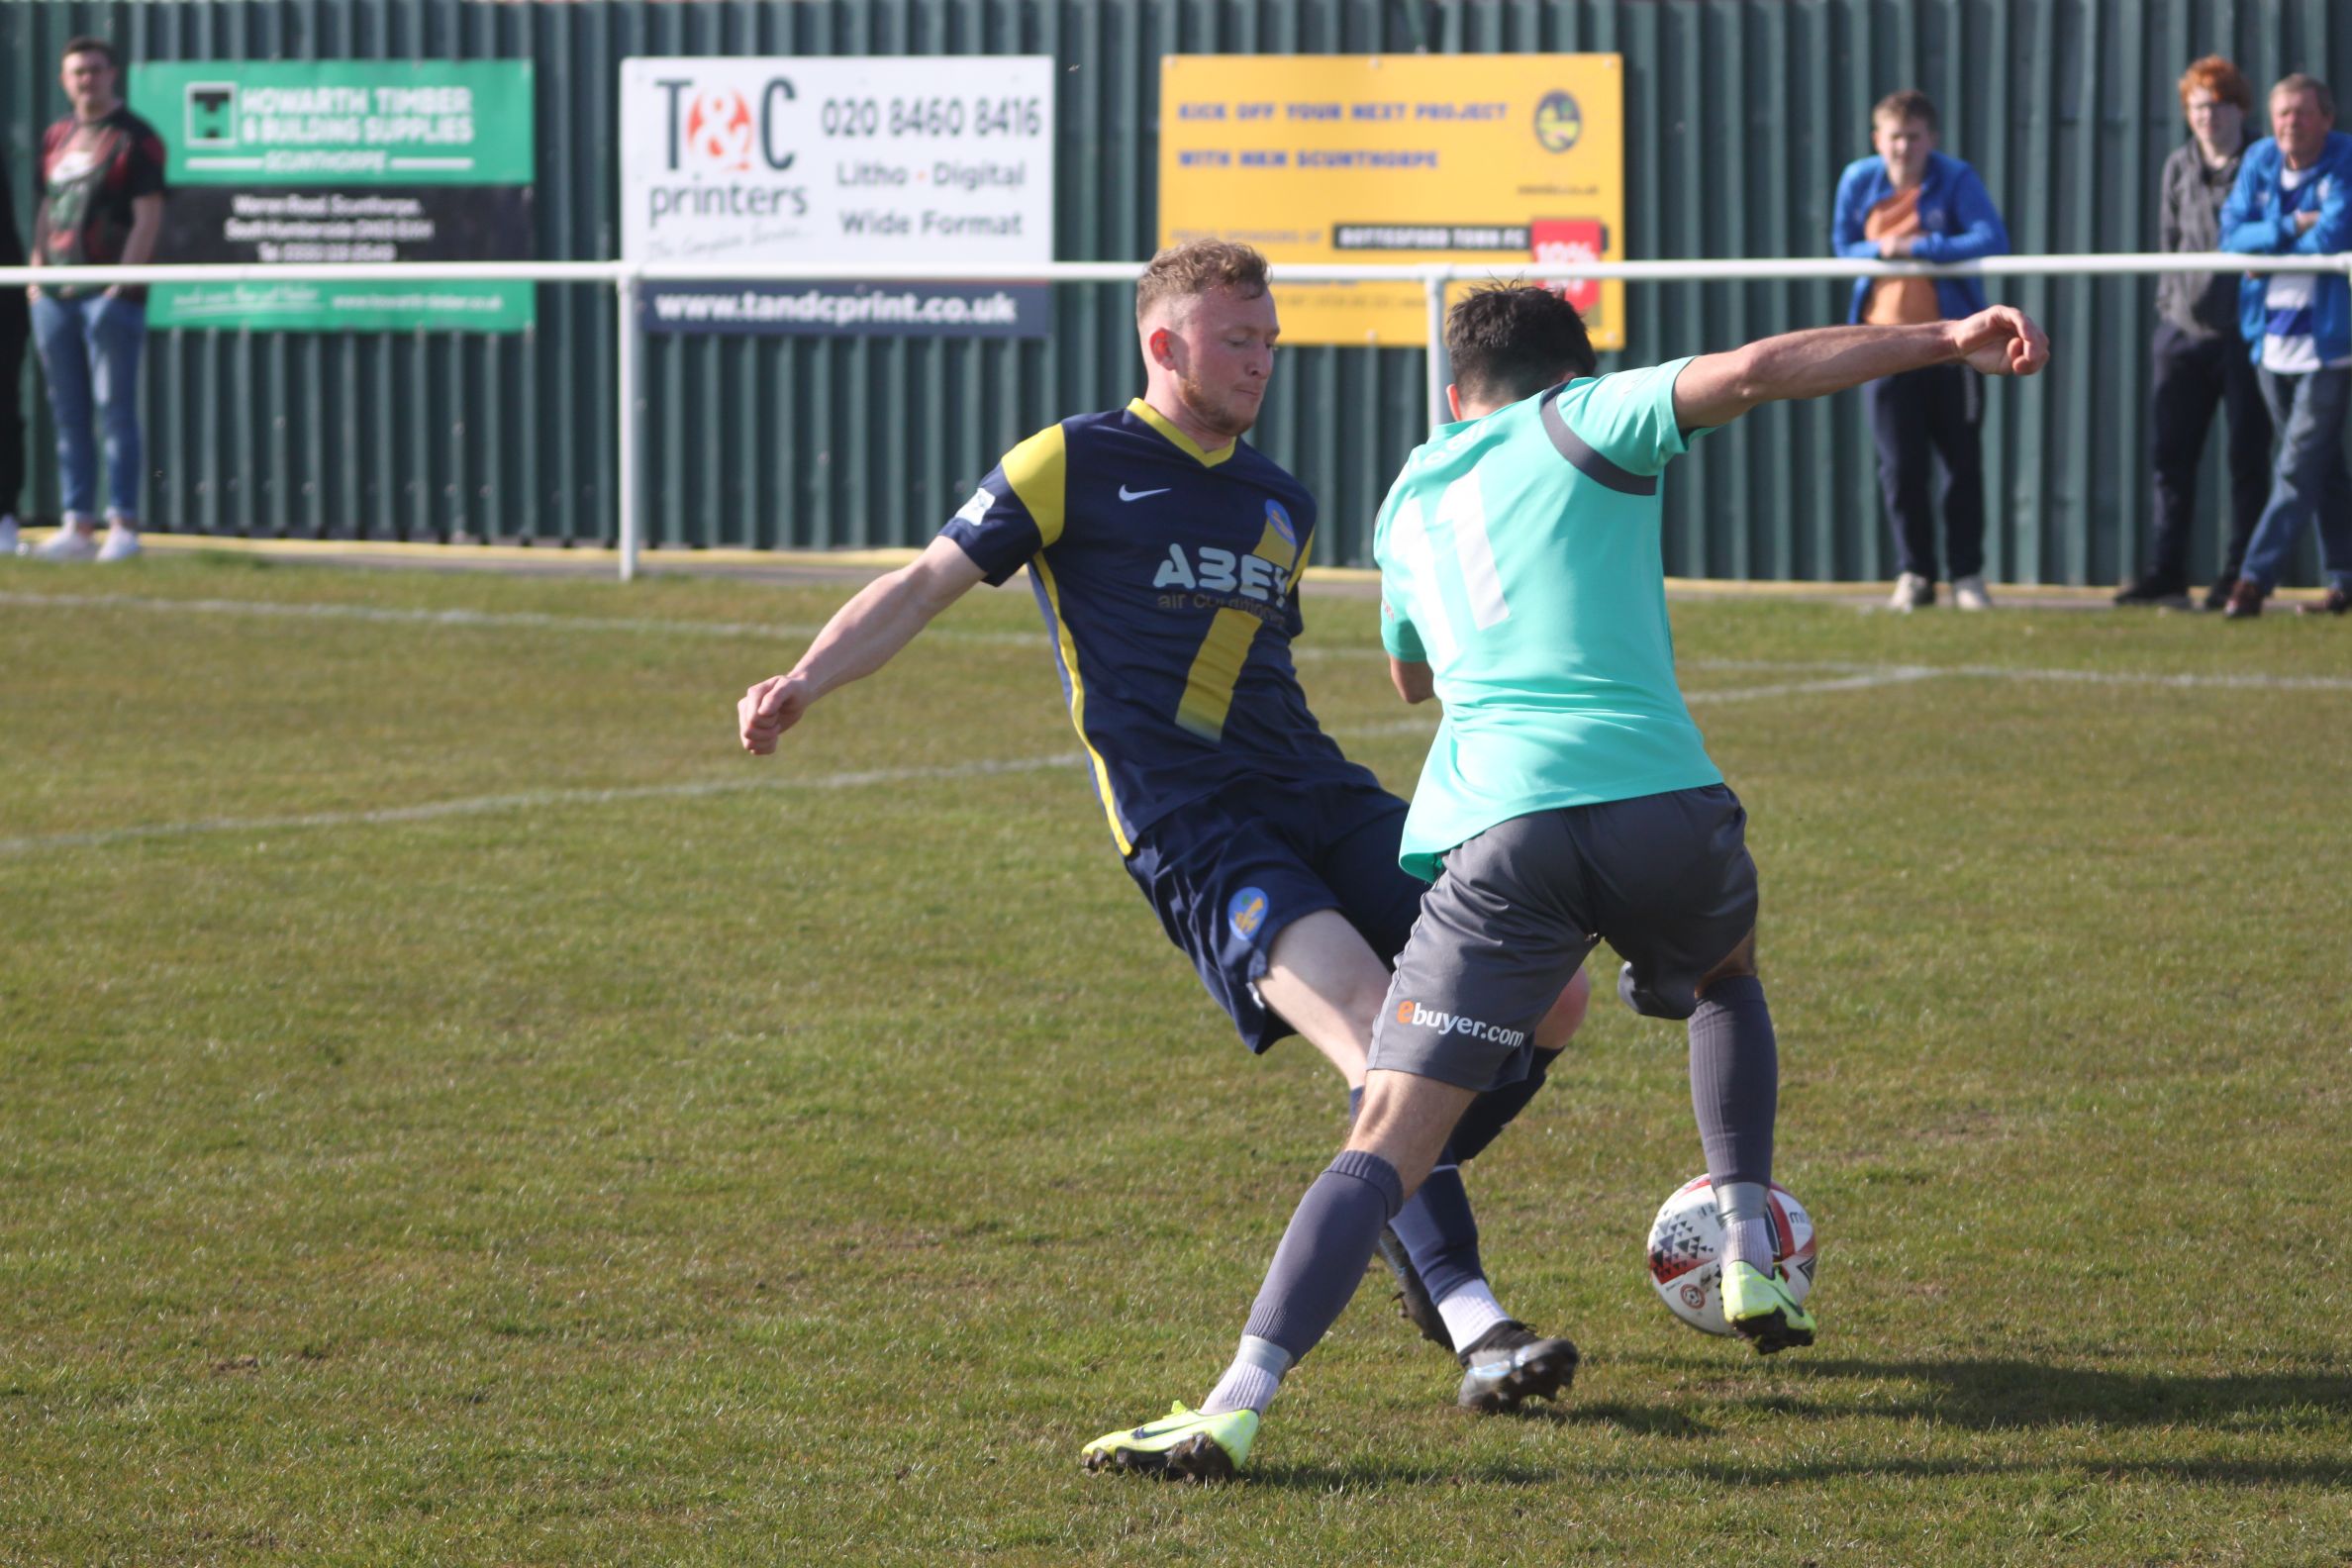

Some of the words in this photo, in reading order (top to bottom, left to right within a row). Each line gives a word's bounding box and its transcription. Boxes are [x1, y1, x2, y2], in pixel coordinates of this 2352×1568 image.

[242, 86, 369, 114] HOWARTH
[375, 86, 472, 115] TIMBER
[1179, 104, 1226, 120] KICK
[1237, 104, 1275, 120] OFF
[1288, 104, 1341, 120] YOUR
[1352, 103, 1406, 120] NEXT
[1417, 103, 1507, 119] PROJECT
[261, 117, 360, 144] BUILDING
[364, 118, 473, 145] SUPPLIES
[823, 98, 877, 137] 020
[890, 98, 964, 137] 8460
[975, 98, 1041, 137] 8416
[1179, 151, 1230, 167] WITH
[1298, 150, 1438, 168] SCUNTHORPE
[836, 161, 907, 187] Litho
[933, 161, 1026, 191] Digital
[649, 175, 808, 227] printers
[840, 209, 910, 236] Wide
[921, 208, 1023, 236] Format
[655, 291, 1018, 327] www.tandcprint.co.uk
[1397, 1000, 1524, 1047] ebuyer.com
